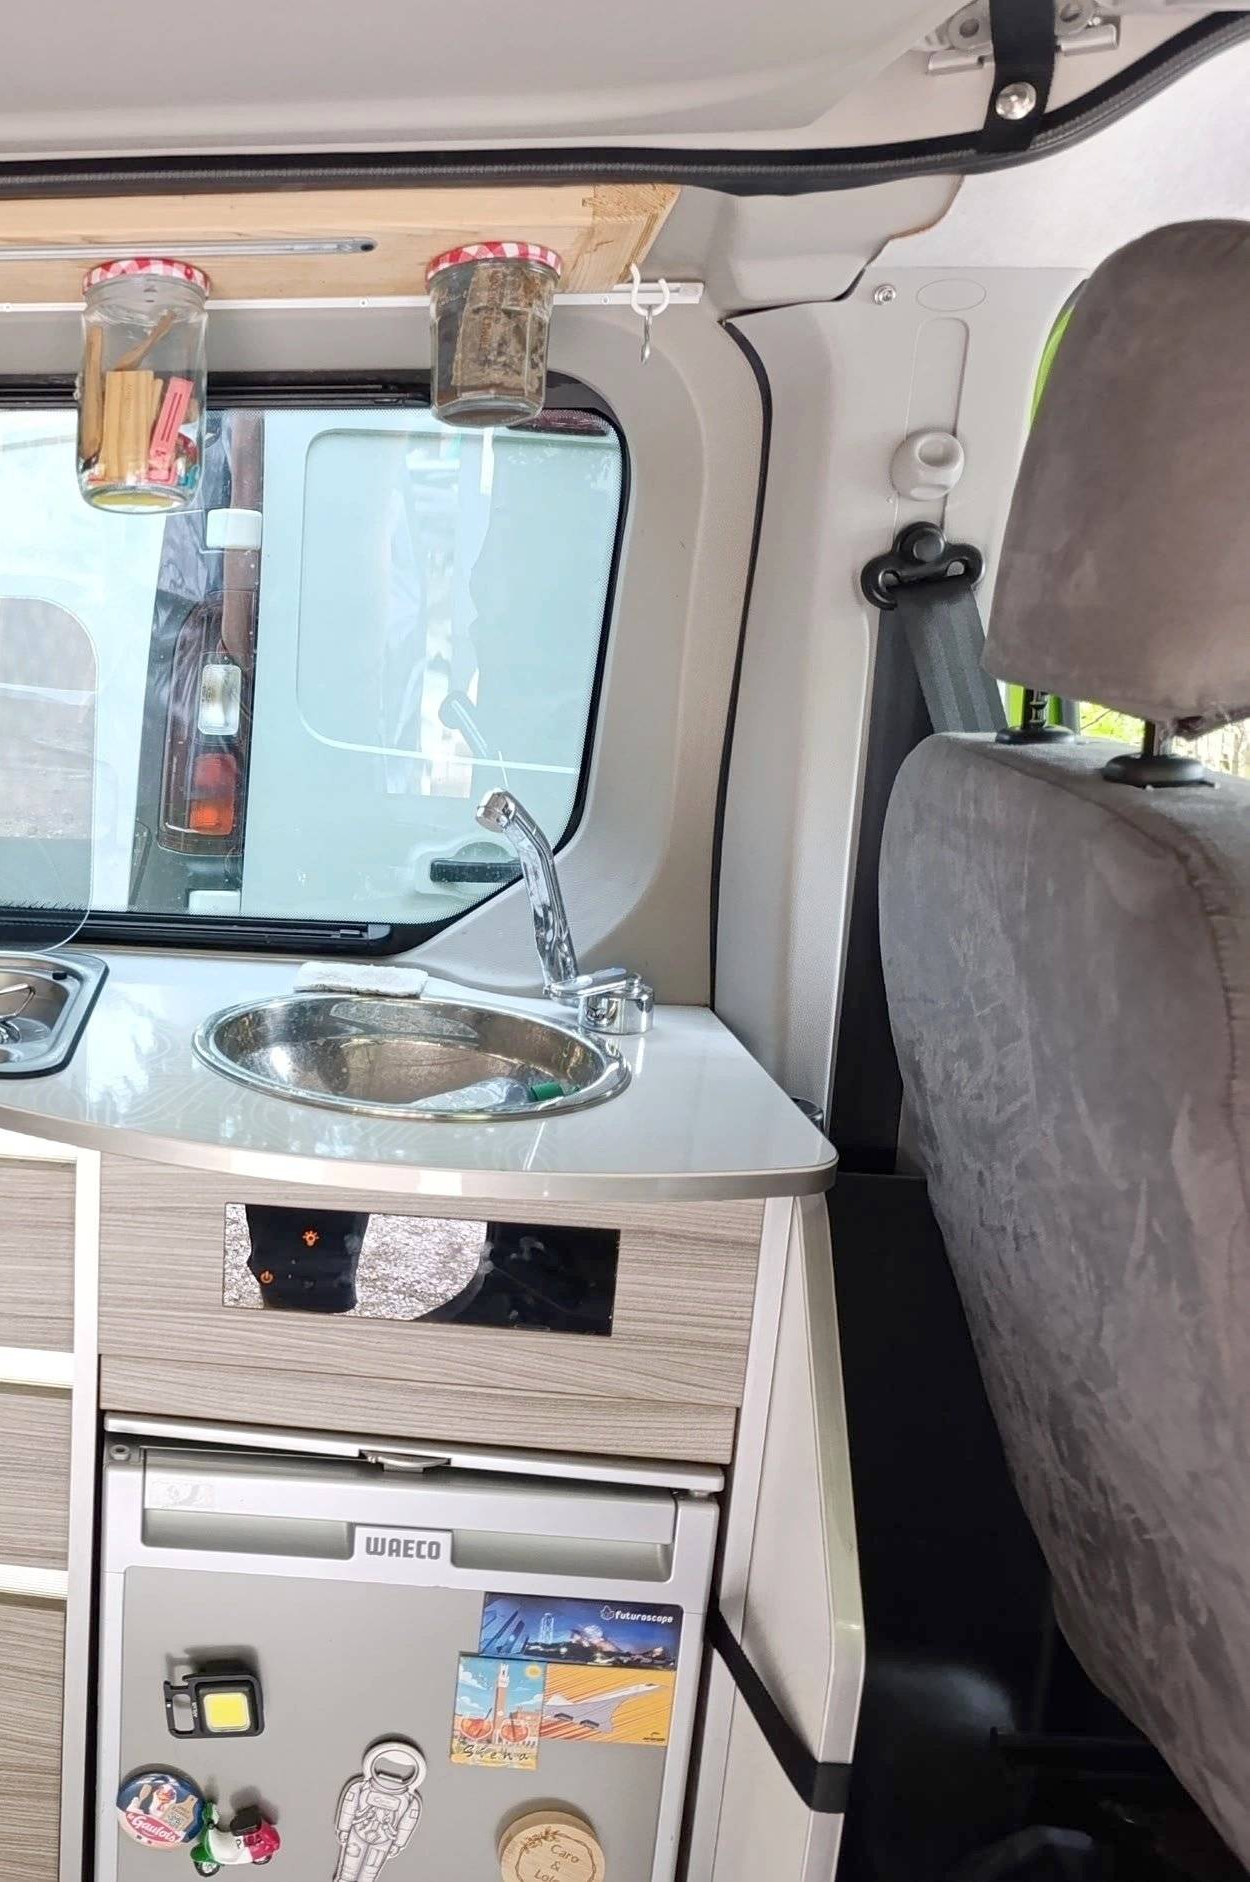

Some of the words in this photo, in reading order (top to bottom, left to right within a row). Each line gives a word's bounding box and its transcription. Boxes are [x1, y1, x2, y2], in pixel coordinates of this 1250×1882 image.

[365, 1536, 441, 1560] WAECO
[615, 1610, 674, 1625] futuroscope
[131, 1815, 177, 1842] Gaulois
[550, 1844, 580, 1863] Caro
